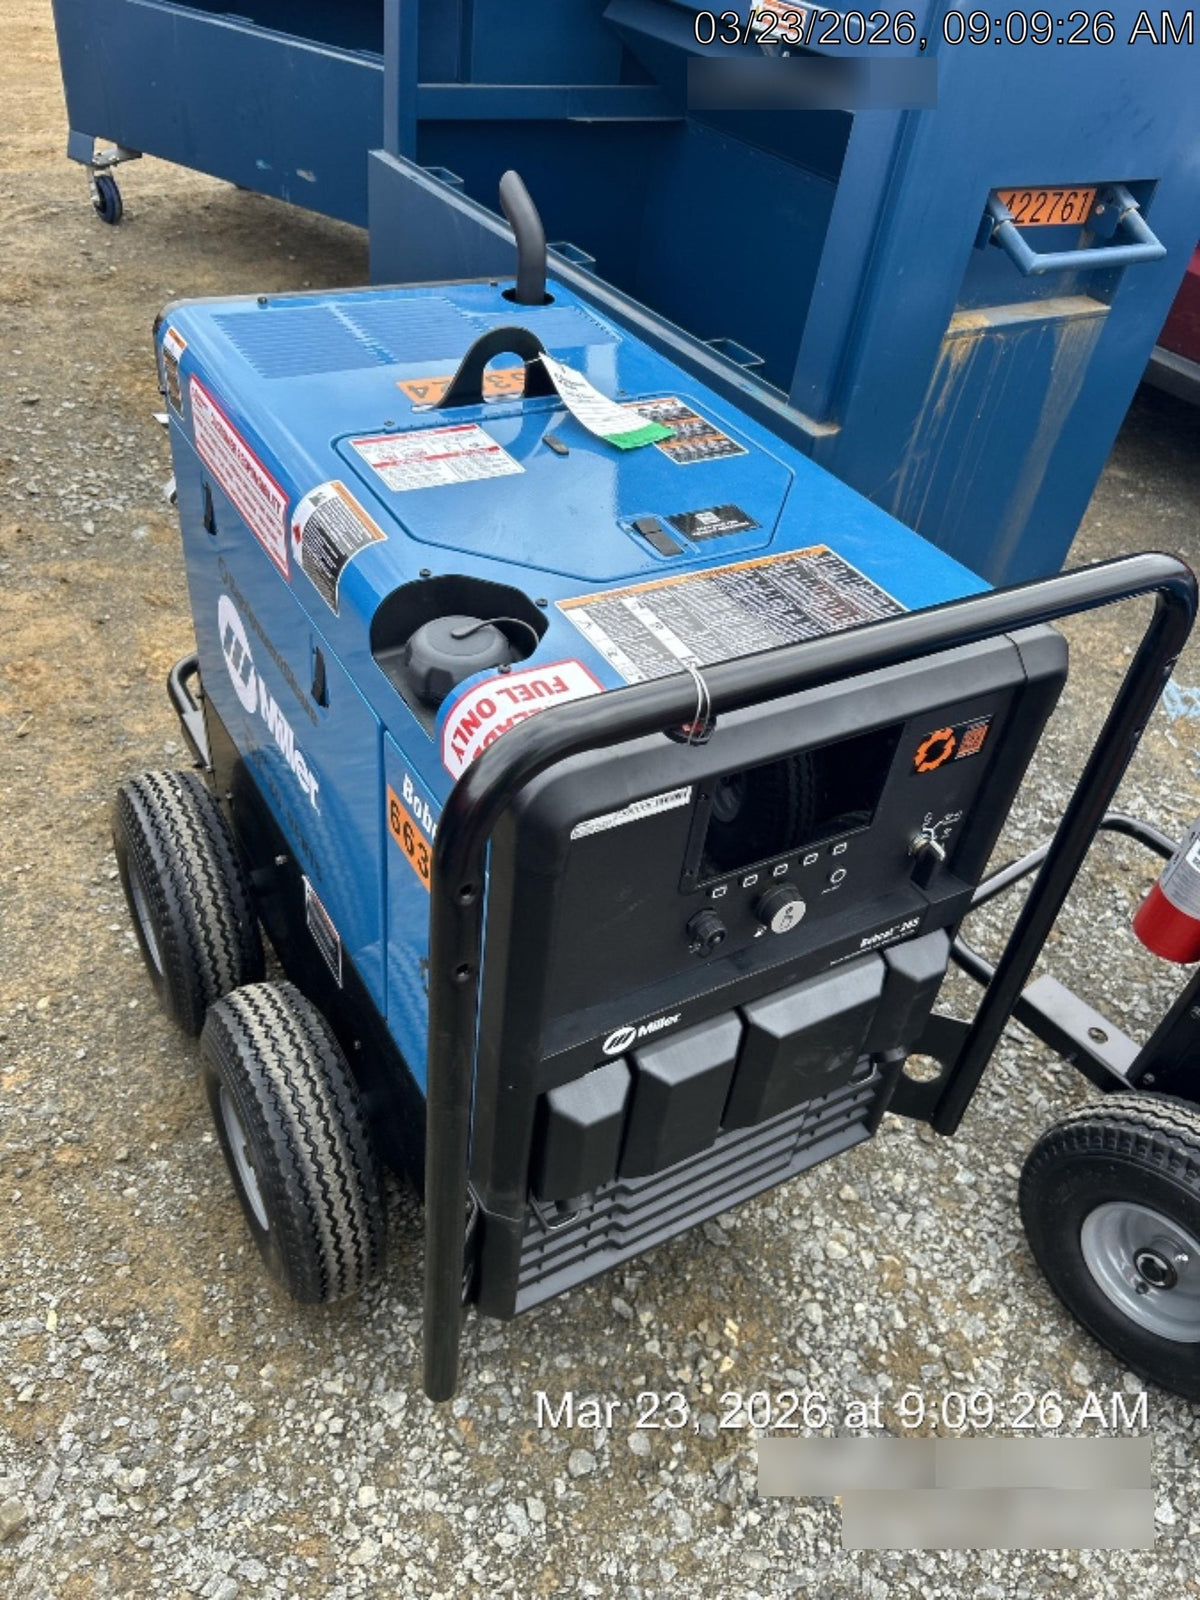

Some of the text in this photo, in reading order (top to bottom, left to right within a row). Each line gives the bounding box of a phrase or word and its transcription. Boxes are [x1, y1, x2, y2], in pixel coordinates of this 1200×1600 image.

[495, 675, 570, 704] FUEL
[257, 673, 321, 816] Miller
[450, 697, 497, 764] ONLY
[637, 1012, 682, 1038] Miller
